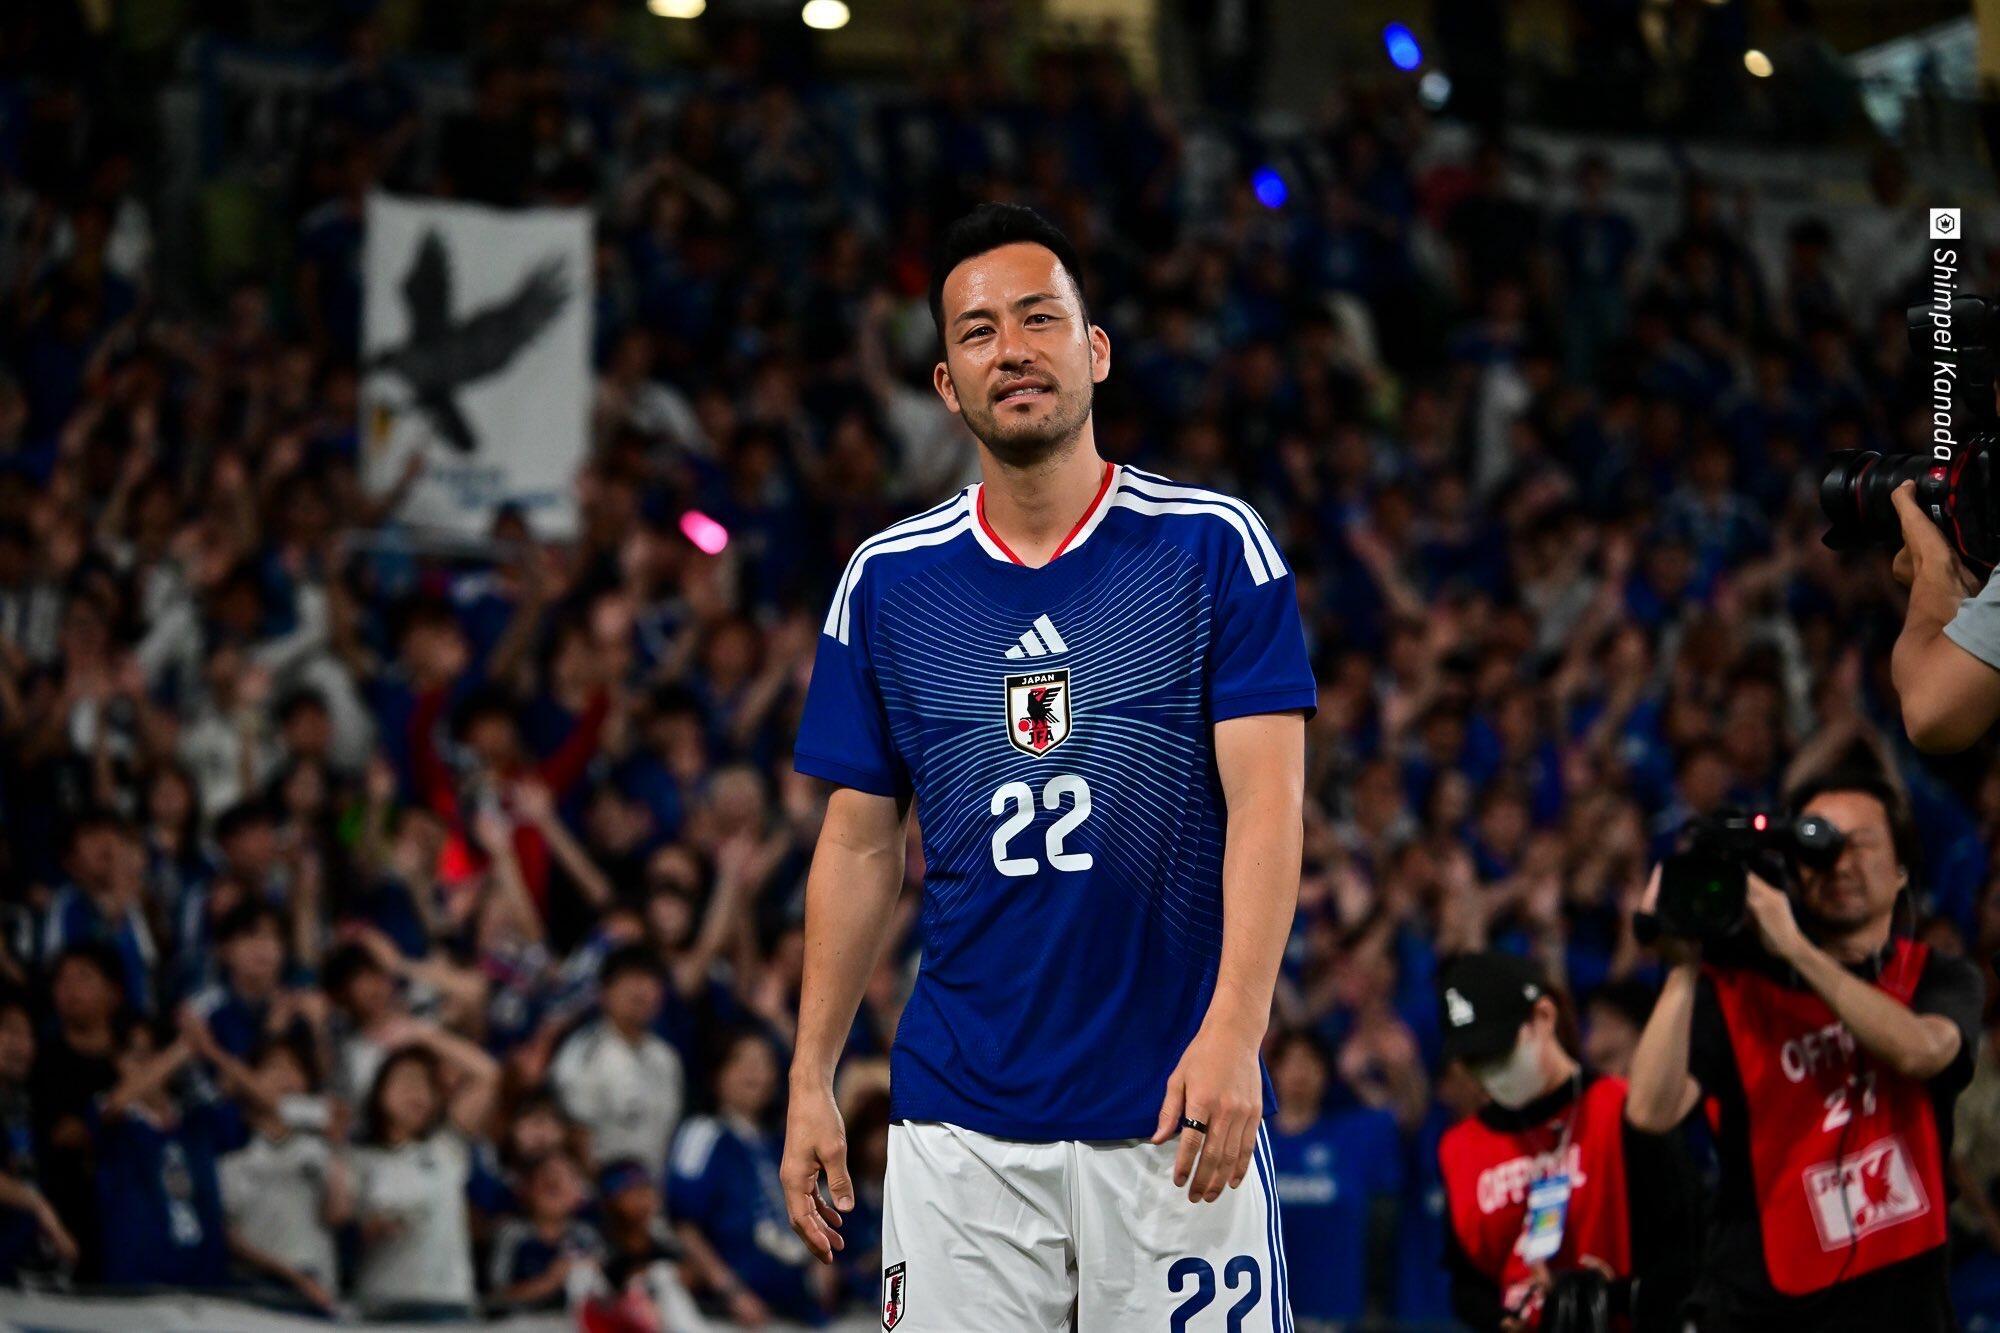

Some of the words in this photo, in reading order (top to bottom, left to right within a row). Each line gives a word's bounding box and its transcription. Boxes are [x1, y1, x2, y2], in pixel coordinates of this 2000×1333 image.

[1021, 674, 1055, 685] JAPAN
[1027, 729, 1055, 745] JFA
[990, 774, 1094, 877] 22
[1167, 1254, 1262, 1333] 22
